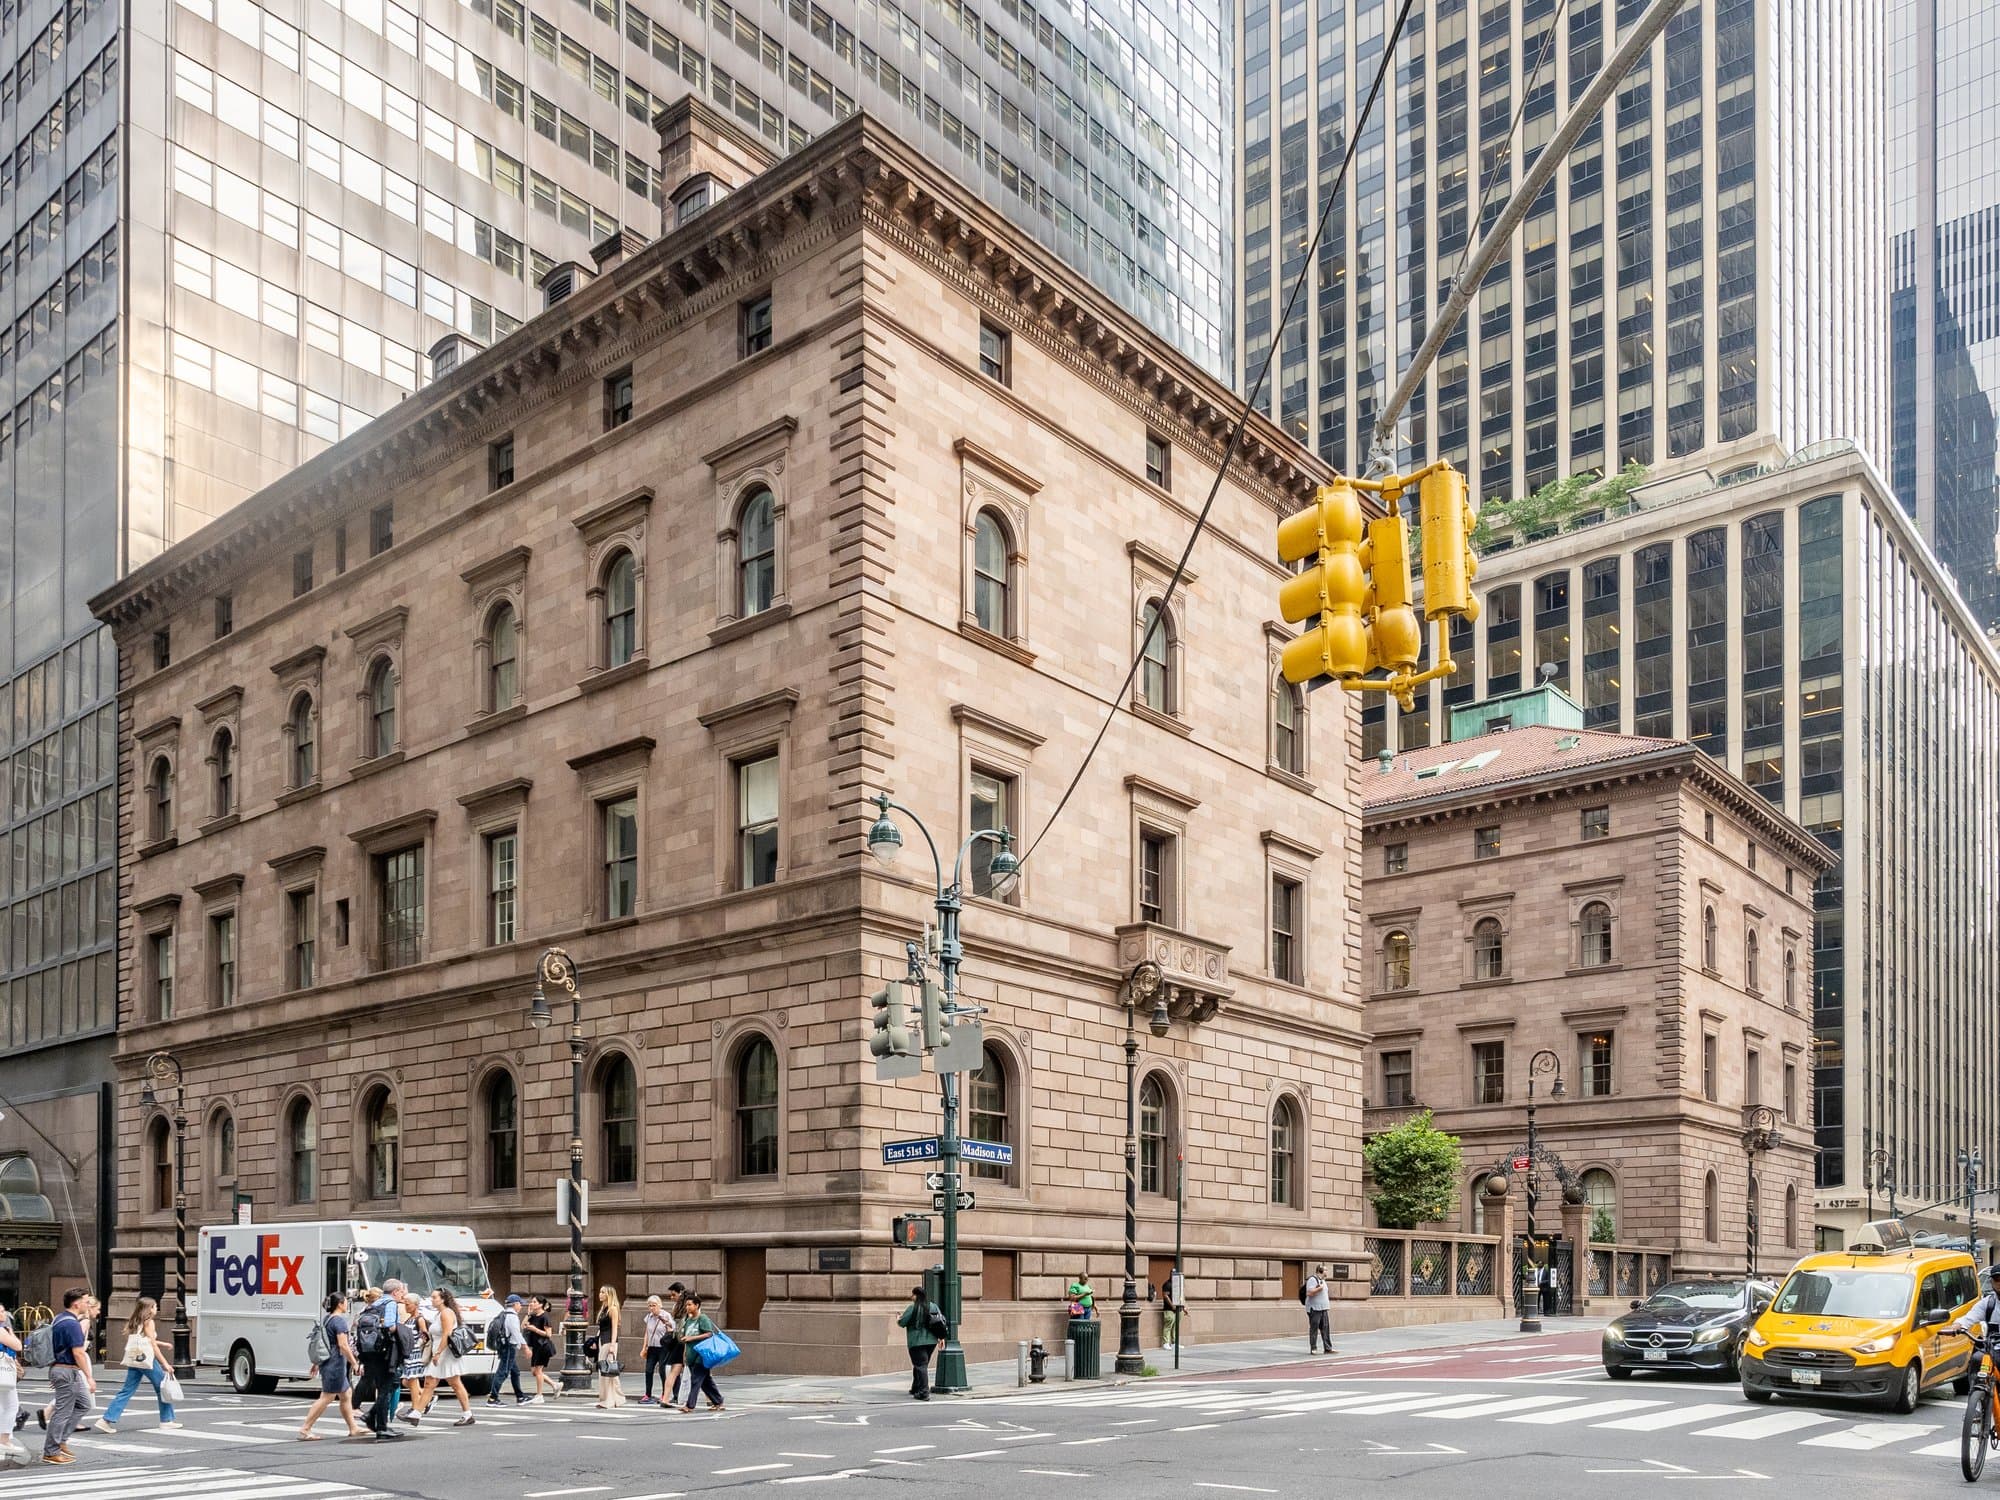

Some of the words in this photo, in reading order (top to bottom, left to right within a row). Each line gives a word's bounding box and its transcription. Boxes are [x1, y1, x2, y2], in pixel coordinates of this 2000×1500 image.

[888, 1148, 905, 1158] East
[906, 1146, 922, 1157] 51st
[925, 1144, 935, 1154] St
[962, 1144, 996, 1158] Madison
[996, 1149, 1012, 1161] Ave
[1829, 1200, 1844, 1208] 437
[209, 1233, 305, 1296] FedEx
[261, 1298, 283, 1310] Express
